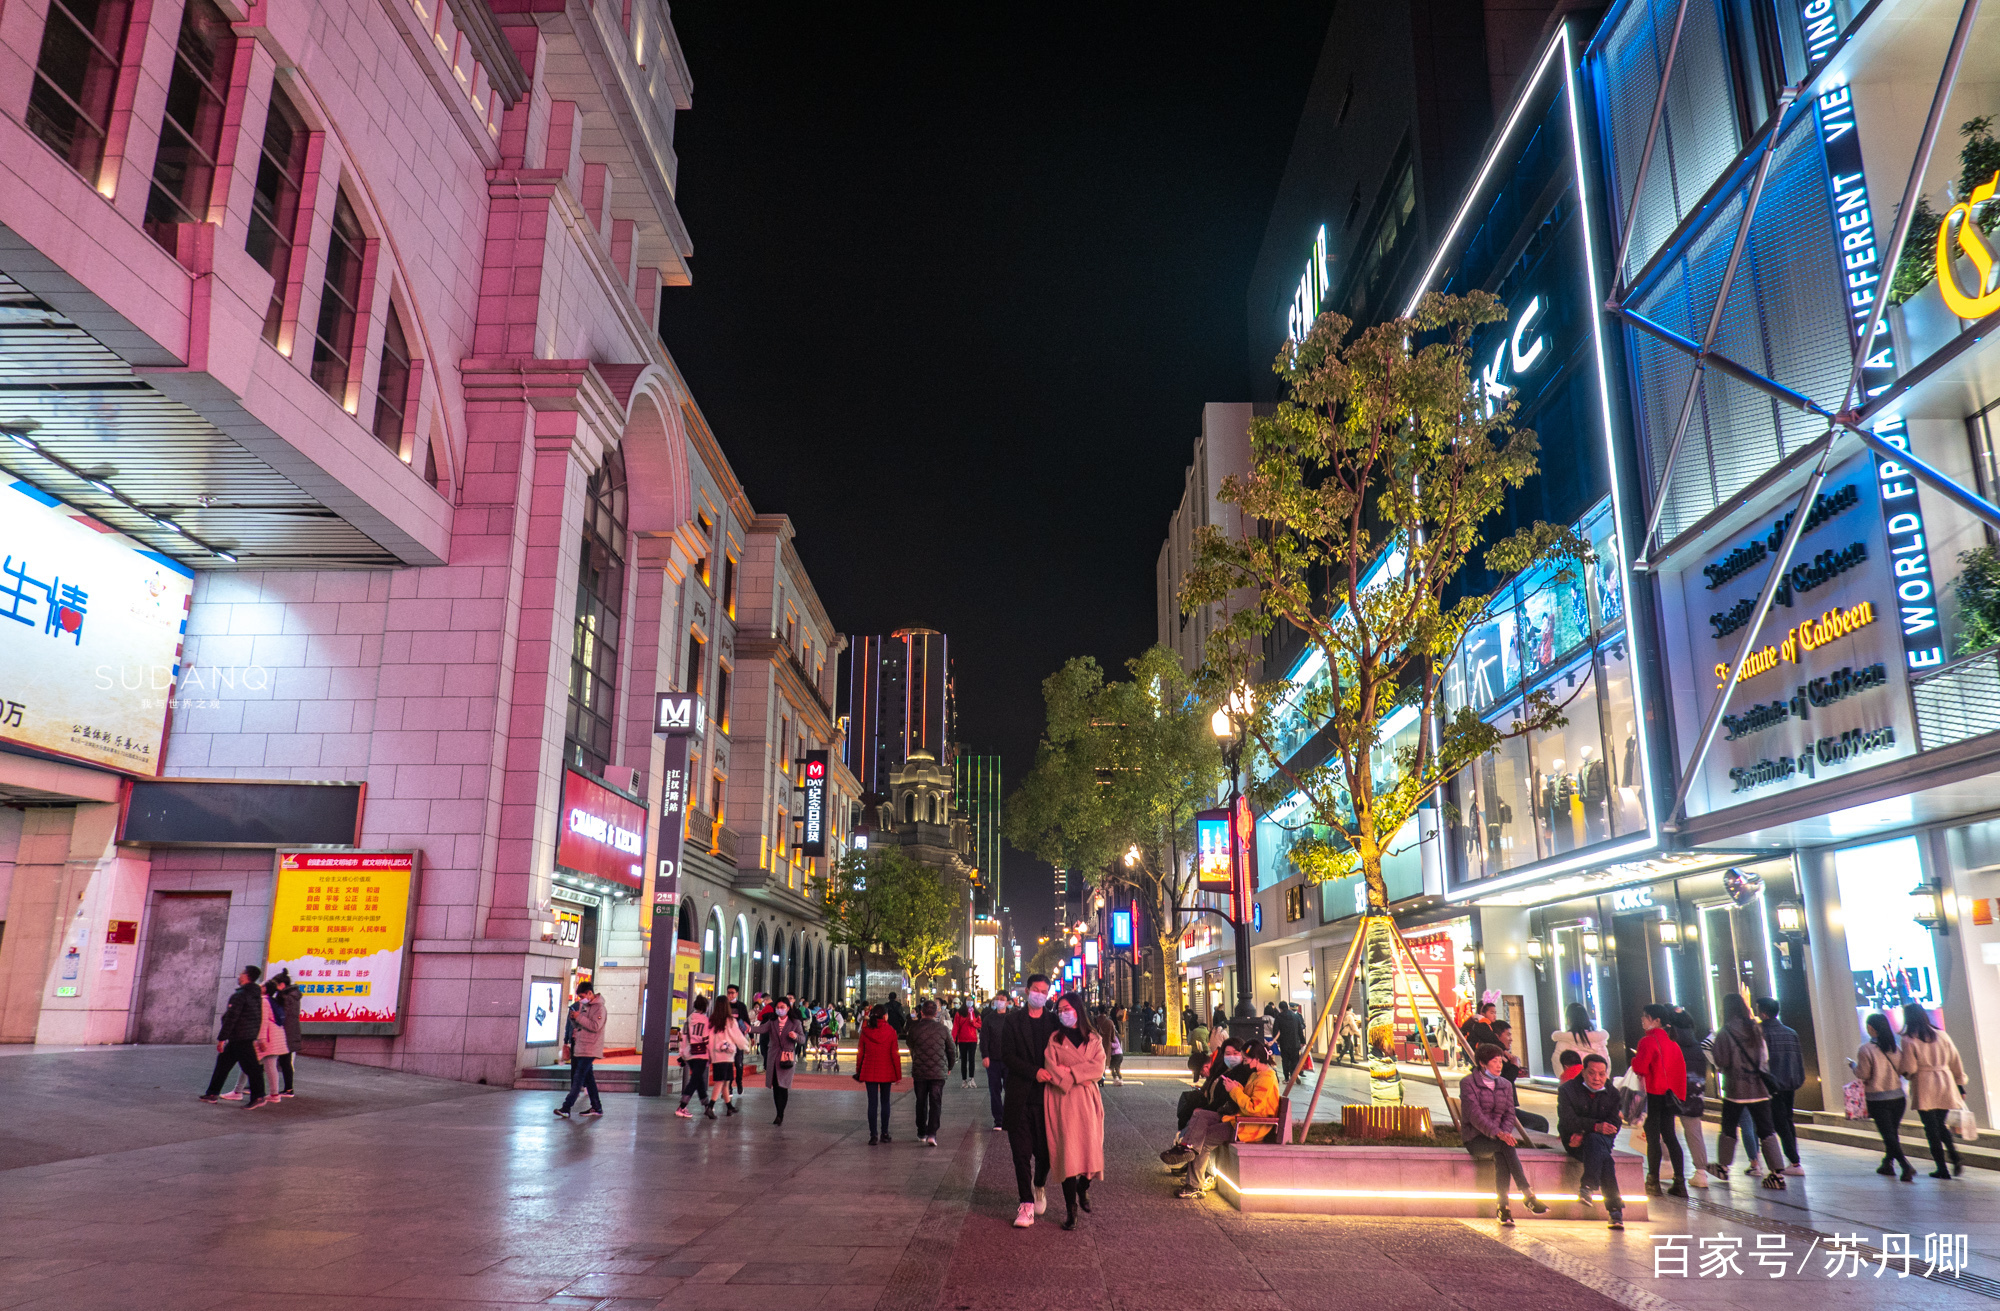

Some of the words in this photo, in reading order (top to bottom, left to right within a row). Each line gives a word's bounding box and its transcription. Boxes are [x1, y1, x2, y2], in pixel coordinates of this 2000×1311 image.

[1863, 347, 1894, 369] A
[1888, 512, 1937, 636] WORLD
[1714, 645, 1778, 690] Ititute
[1781, 628, 1796, 664] of
[1799, 601, 1873, 651] Cabbeen
[72, 724, 112, 744] 公益体彩
[114, 735, 150, 754] 乐善人生
[668, 769, 681, 812] 江汉路站
[806, 779, 824, 787] DAY
[659, 860, 674, 877] D
[326, 886, 340, 894] 民主
[345, 886, 359, 894] 文明
[1613, 886, 1653, 911] KKC
